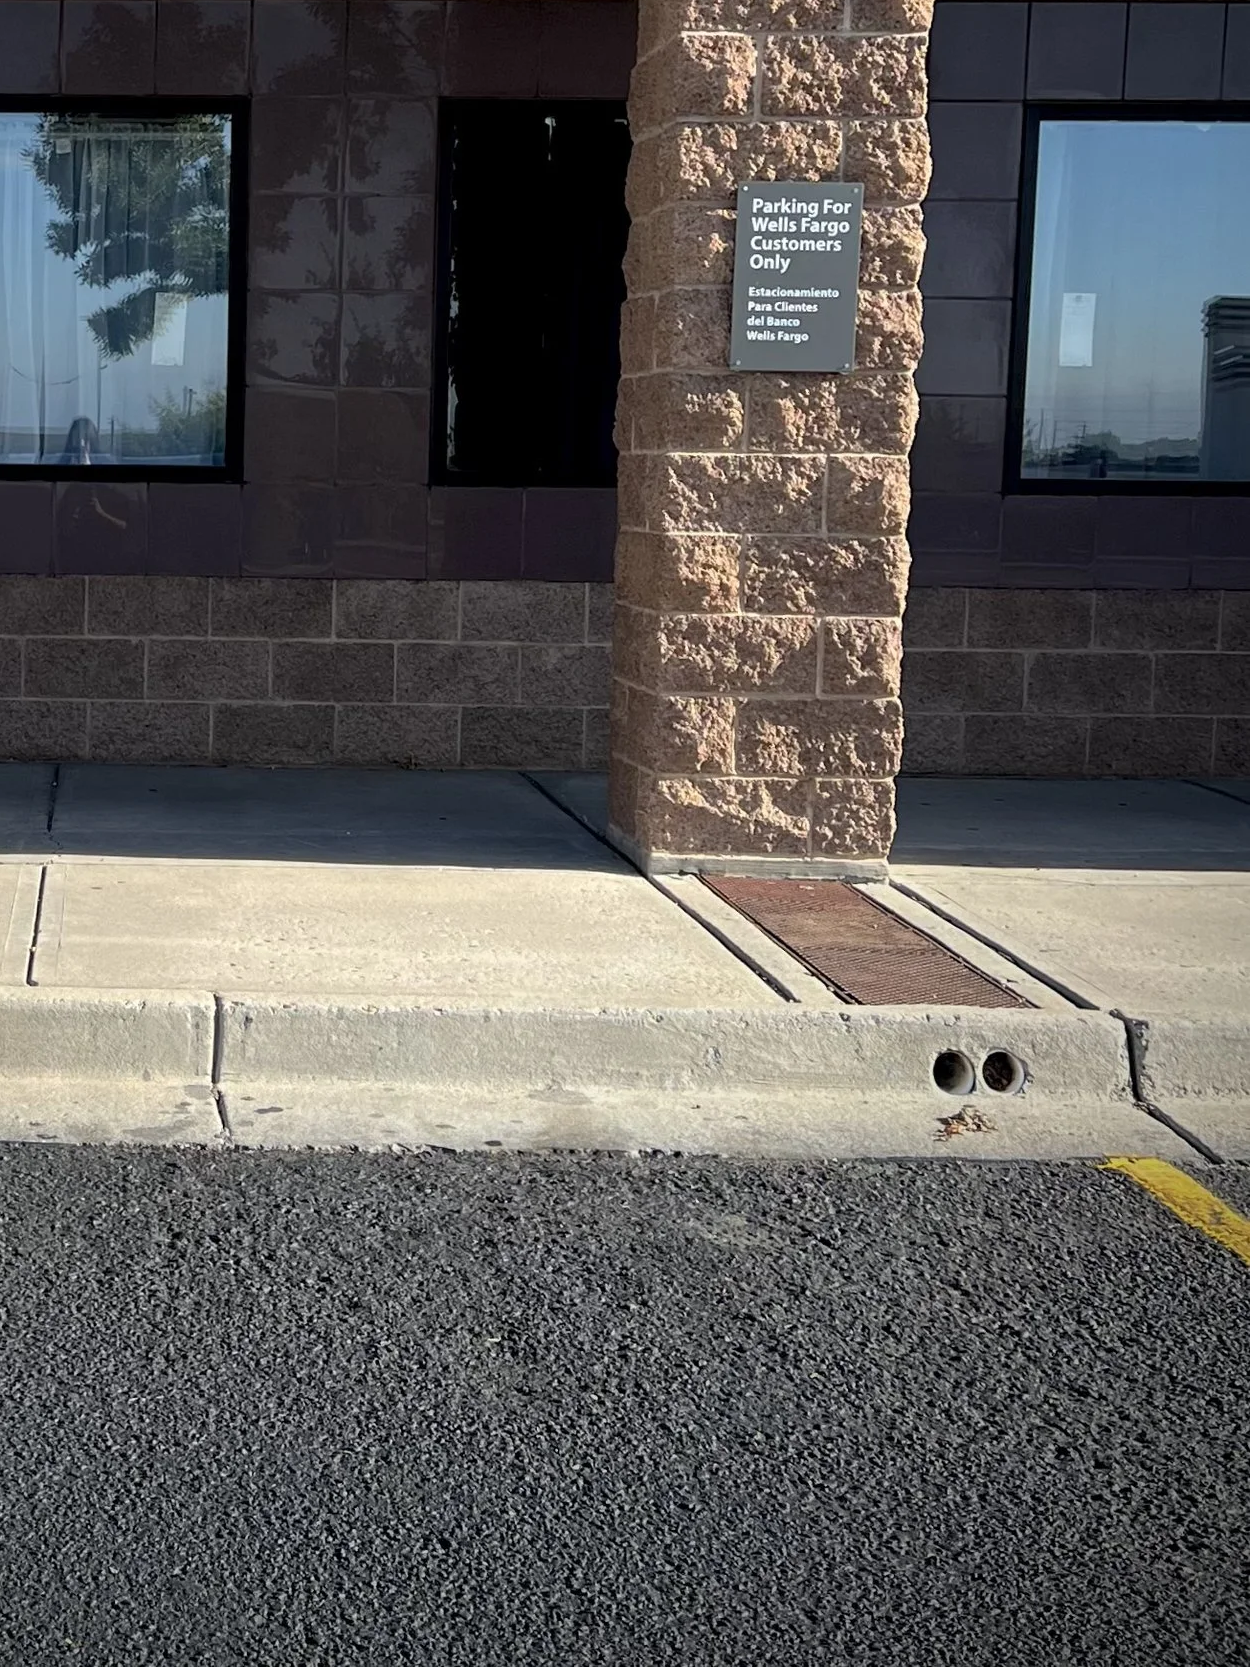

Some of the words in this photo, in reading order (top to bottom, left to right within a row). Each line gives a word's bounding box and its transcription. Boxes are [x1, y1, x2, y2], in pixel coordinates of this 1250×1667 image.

[752, 198, 819, 217] Parking
[823, 199, 852, 215] For
[751, 217, 797, 233] Wells
[801, 218, 850, 236] Fargo
[750, 236, 842, 252] Customers
[749, 254, 791, 273] Only
[748, 286, 840, 298] Estacionamiento
[747, 301, 772, 312] Para
[774, 301, 818, 313] Clientes
[747, 315, 764, 326] del
[767, 316, 800, 327] Banco
[746, 331, 776, 341] Wells
[777, 331, 809, 343] Fargo
